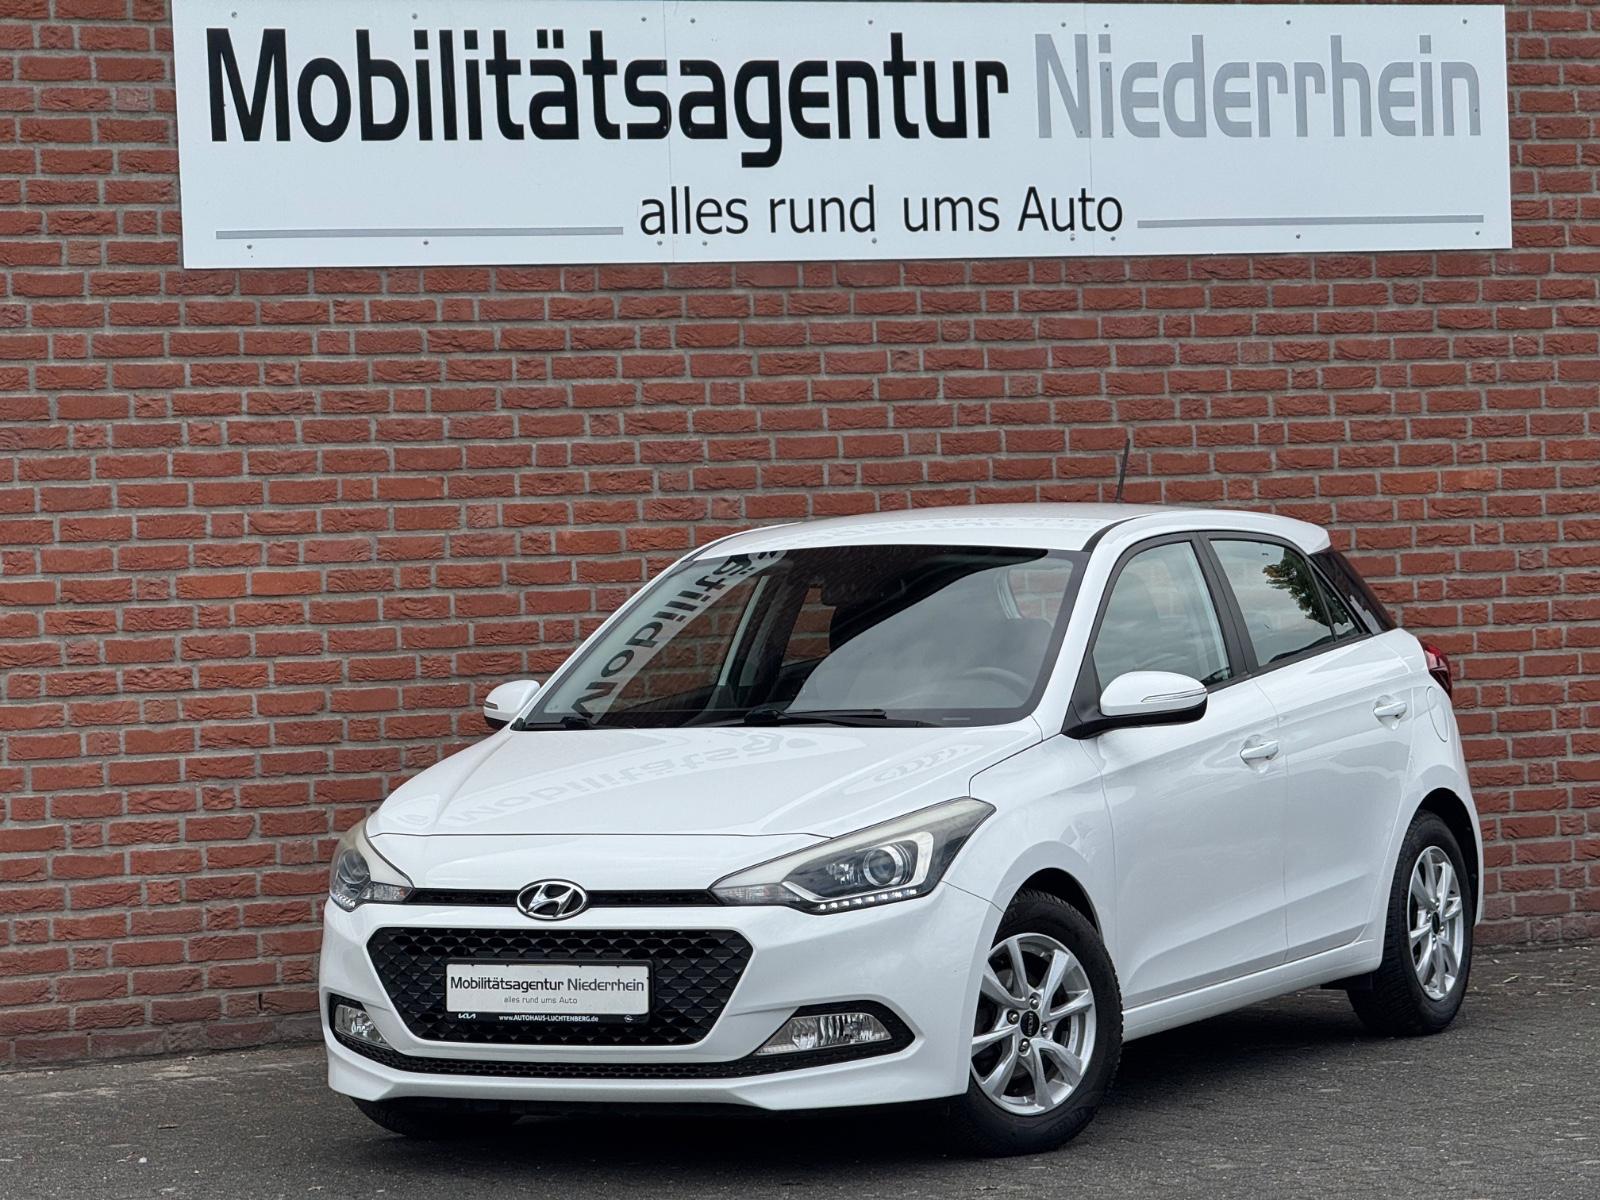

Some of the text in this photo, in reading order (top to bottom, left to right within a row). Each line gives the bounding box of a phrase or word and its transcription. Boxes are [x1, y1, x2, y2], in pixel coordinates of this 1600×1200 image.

[206, 27, 1482, 169] Mobilitätsagentur Niederrhein
[640, 184, 1123, 235] alles rund ums Auto
[450, 976, 645, 993] Mobilitätsagentur Niederrhein
[503, 996, 578, 1005] alles rund ums Auto
